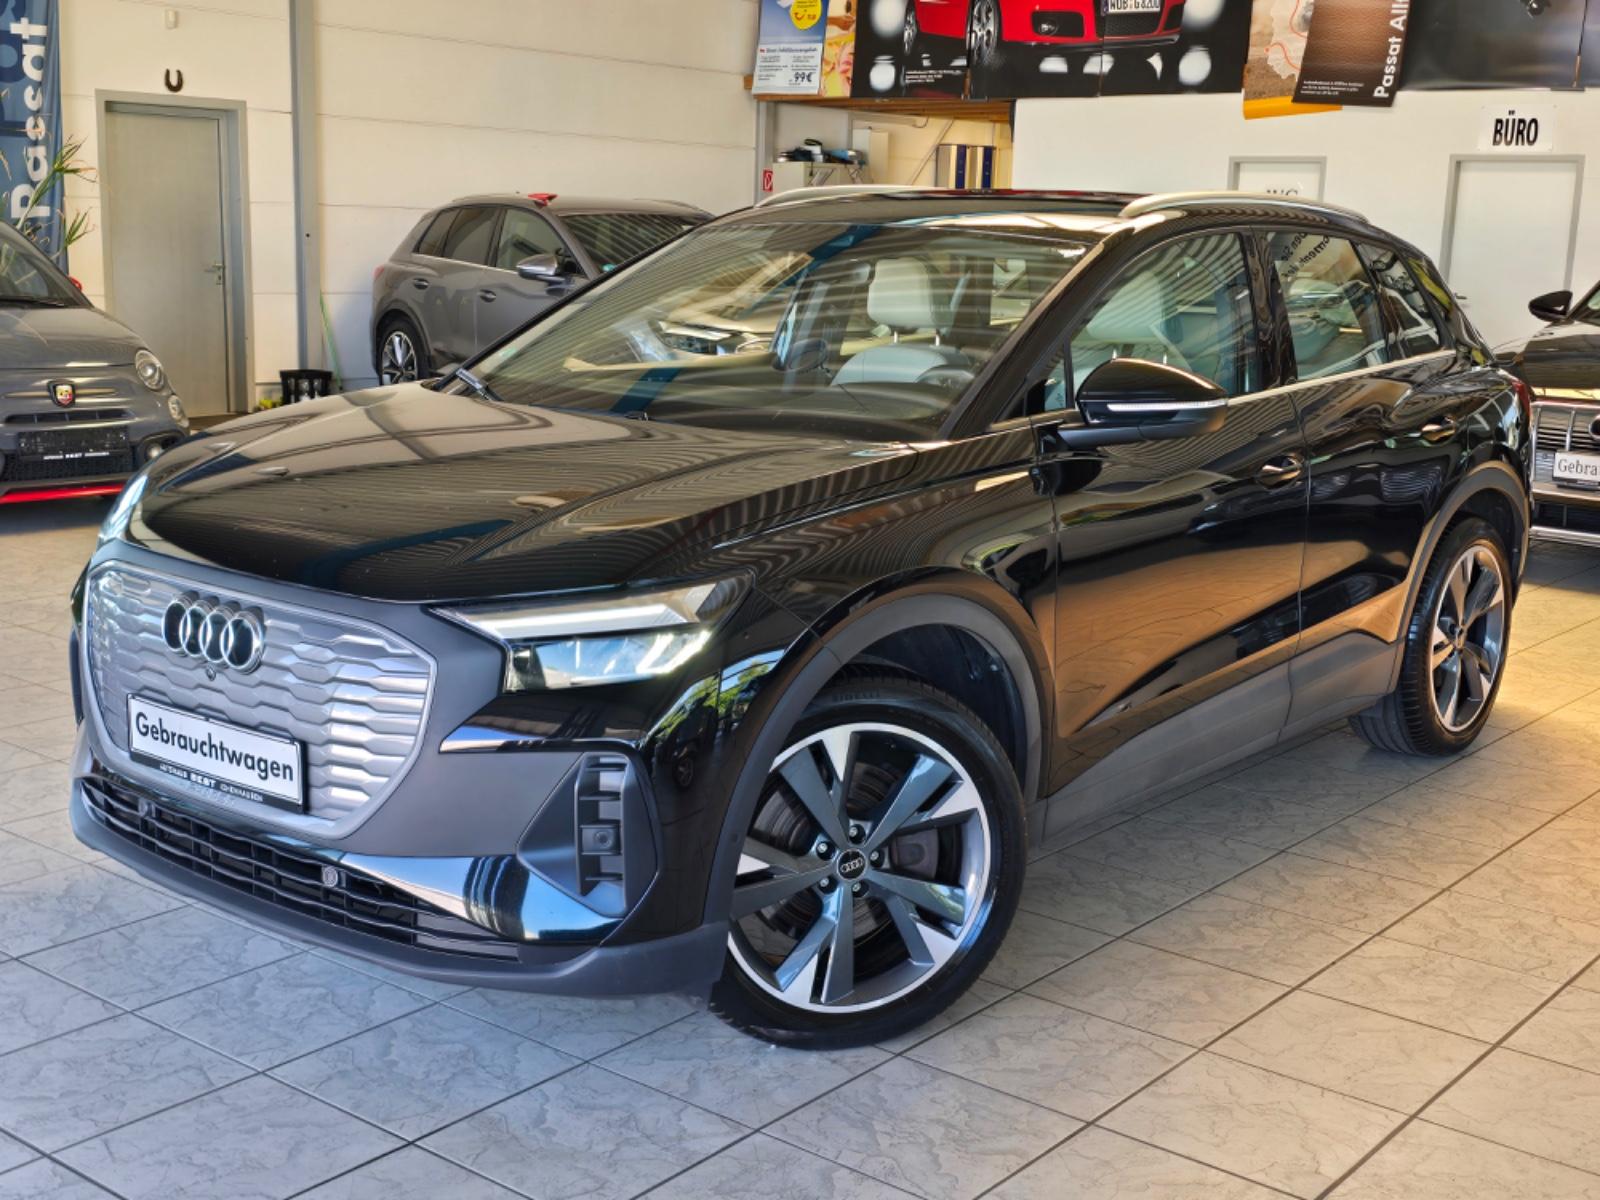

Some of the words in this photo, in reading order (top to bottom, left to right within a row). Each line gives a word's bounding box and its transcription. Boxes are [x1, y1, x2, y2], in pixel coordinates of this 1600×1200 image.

[1373, 36, 1403, 98] Passat
[1389, 0, 1410, 31] All
[10, 17, 50, 218] Passat
[1492, 109, 1539, 146] BÜRO
[1558, 459, 1600, 476] Gebra
[135, 711, 294, 782] Gebrauchtwagen
